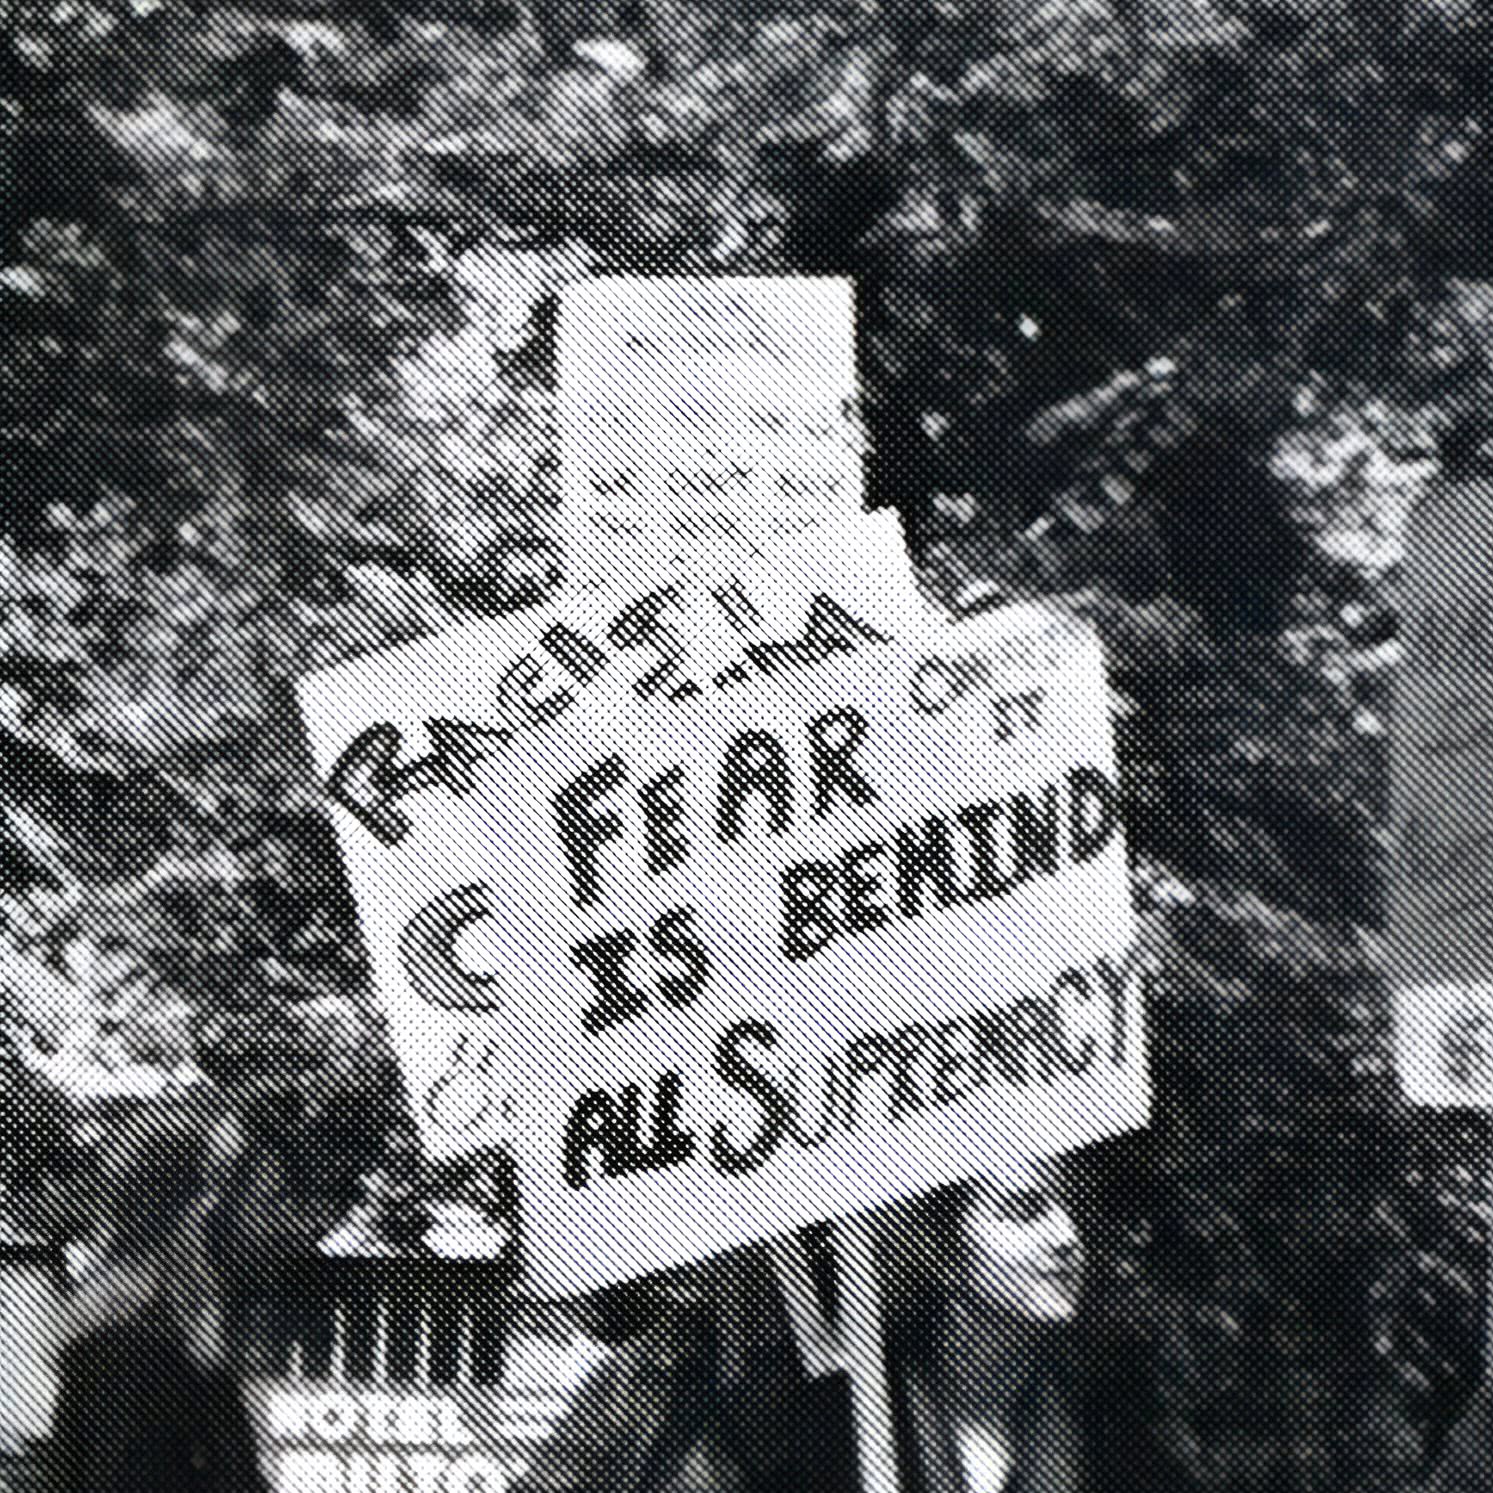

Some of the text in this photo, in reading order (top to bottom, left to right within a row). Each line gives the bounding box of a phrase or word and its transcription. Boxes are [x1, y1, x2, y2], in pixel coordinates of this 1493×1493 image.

[551, 707, 880, 908] FEAR
[571, 905, 710, 1037] IS
[779, 764, 1117, 962] BEHIND
[561, 1070, 694, 1190] ALL
[707, 947, 1143, 1176] SUPREMACY
[266, 1390, 475, 1446] HOTEL
